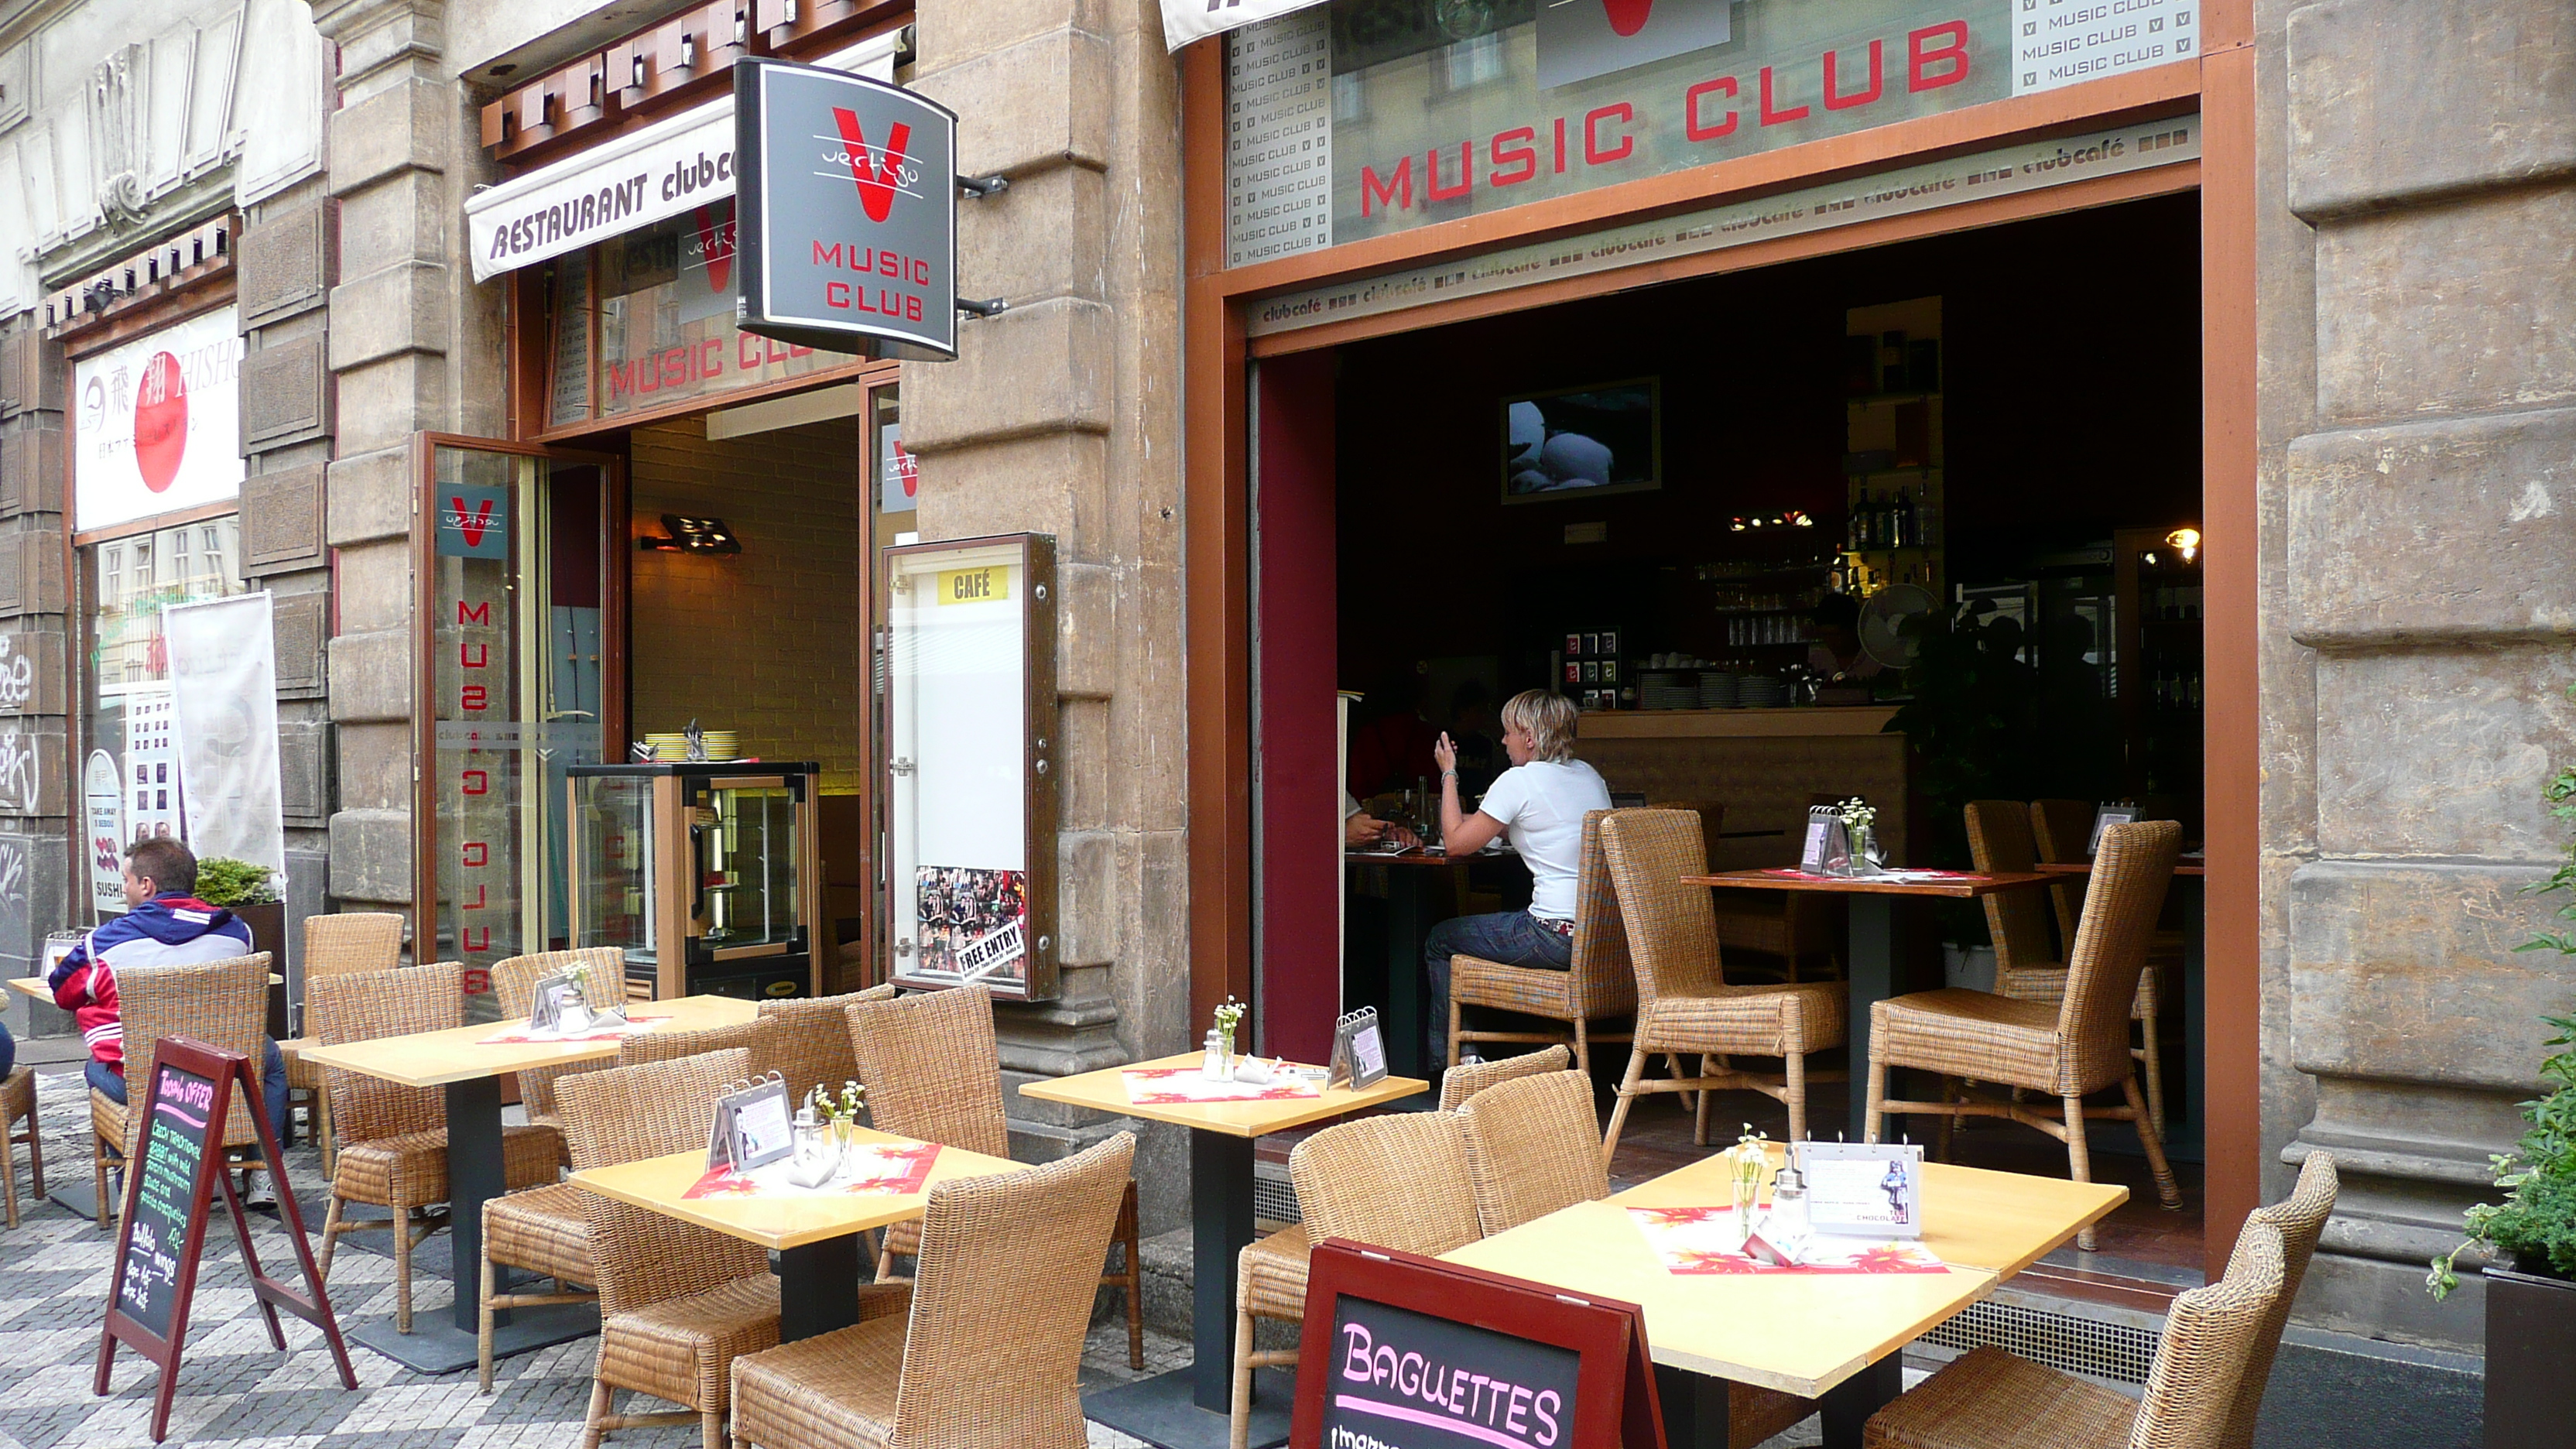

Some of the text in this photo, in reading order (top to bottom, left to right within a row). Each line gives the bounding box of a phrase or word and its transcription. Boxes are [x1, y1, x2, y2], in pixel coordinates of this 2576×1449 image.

[1247, 17, 1279, 34] MUSIC
[2049, 5, 2107, 30] MUSIC
[1261, 32, 1293, 49] MUSIC
[1297, 21, 1324, 36] CLUB
[2023, 38, 2080, 60] MUSIC
[2087, 24, 2136, 46] CLUB
[1247, 54, 1279, 72] MUSIC
[1283, 45, 1310, 61] CLUB
[2050, 57, 2107, 80] MUSIC
[2114, 44, 2163, 66] CLUB
[1232, 77, 1264, 94] MUSIC
[1268, 67, 1296, 84] CLUB
[1247, 92, 1279, 109] MUSIC
[1283, 83, 1310, 99] CLUB
[1262, 107, 1293, 124] MUSIC
[1297, 98, 1325, 114] CLUB
[1361, 19, 1968, 218] MUSIC CLUB
[1247, 130, 1279, 146] MUSIC
[1283, 122, 1310, 137] CLUB
[822, 152, 919, 188] vertigo
[1232, 153, 1265, 170] MUSIC
[1269, 145, 1296, 159] CLUB
[1247, 168, 1279, 184] MUSIC
[1283, 160, 1310, 175] CLUB
[1262, 183, 1294, 199] MUSIC
[1298, 176, 1325, 190] CLUB
[489, 173, 647, 260] RESTAURANT
[1248, 206, 1279, 221] MUSIC
[1283, 198, 1310, 214] CLUB
[1233, 228, 1265, 245] MUSIC
[1269, 221, 1297, 235] CLUB
[1263, 298, 1321, 322] clubcafé
[2023, 138, 2125, 173] clubcafé
[1248, 244, 1280, 259] MUSIC
[1283, 238, 1310, 251] CLUB
[813, 240, 929, 286] MUSIC
[827, 282, 922, 322] CLUB
[610, 331, 814, 400] MUSIC CL
[889, 459, 918, 472] verti
[954, 570, 990, 600] CAFÉ
[97, 881, 123, 898] SUSHI
[959, 927, 1017, 971] FREE ENTRY
[186, 1081, 213, 1112] OFFER
[1343, 1323, 1560, 1447] BAGUETTES
